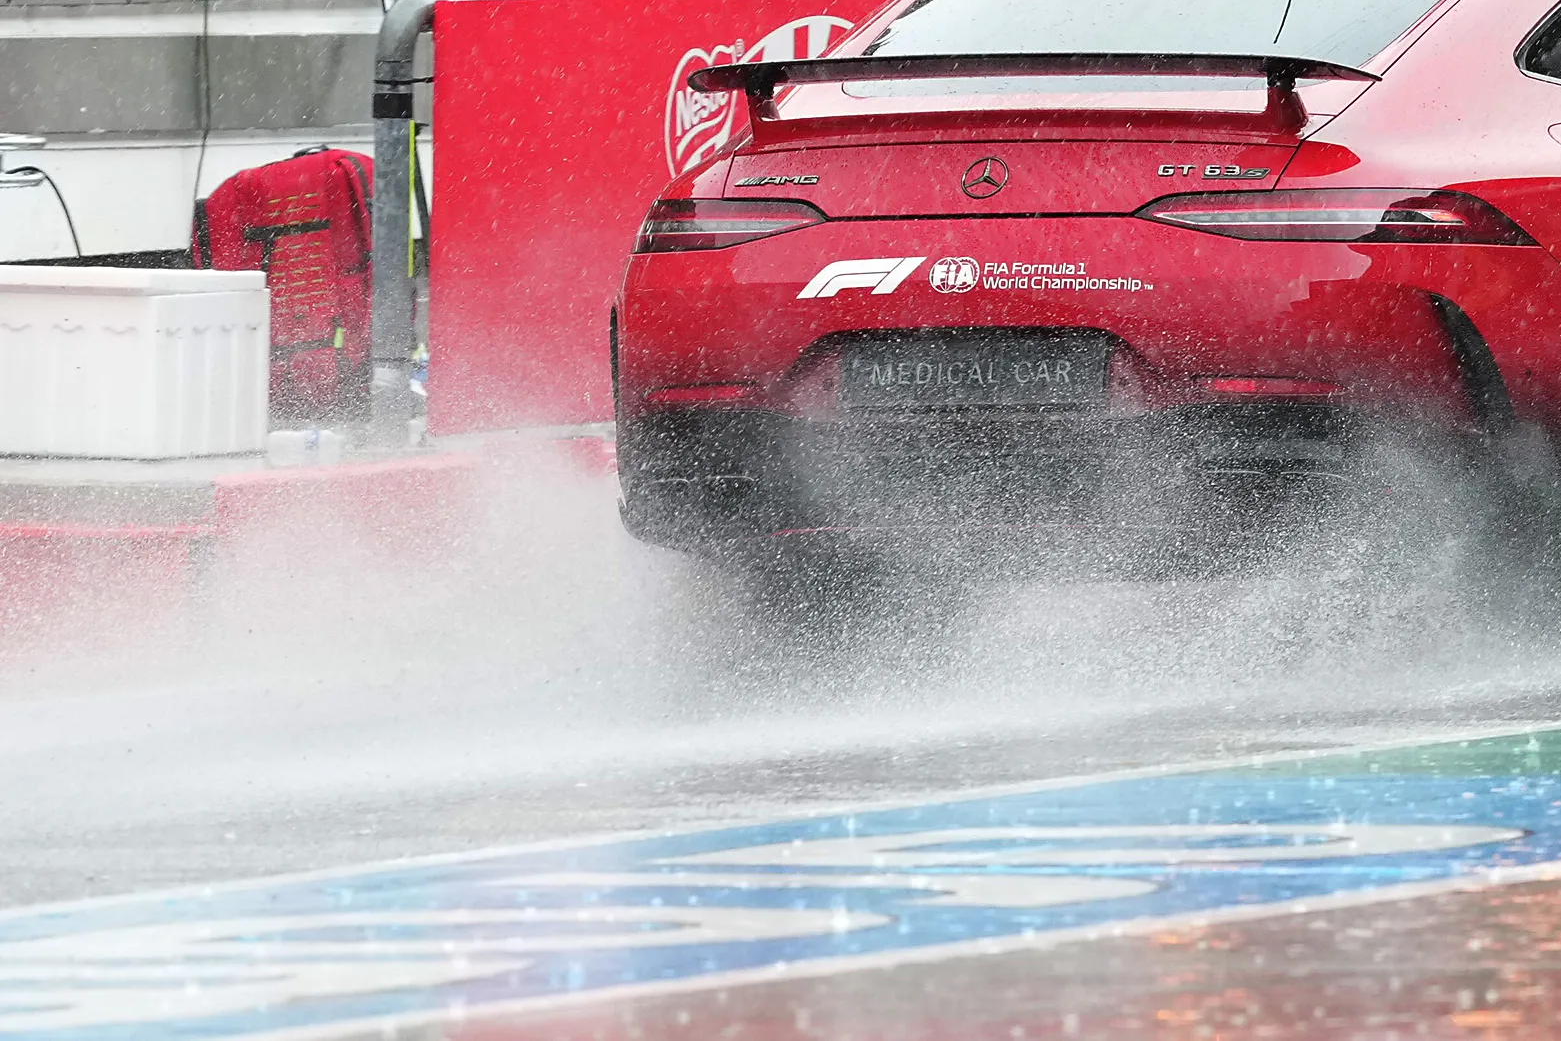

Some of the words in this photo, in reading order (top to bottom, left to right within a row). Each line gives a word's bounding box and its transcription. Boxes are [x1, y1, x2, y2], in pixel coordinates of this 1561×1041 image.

[1157, 164, 1195, 176] GT
[758, 174, 820, 185] AMG
[983, 262, 1008, 275] FIA
[1011, 262, 1075, 275] Formula
[1077, 262, 1086, 274] 1
[983, 276, 1029, 290] World
[871, 361, 1000, 386] MEDICAL
[1014, 361, 1072, 385] CAR
